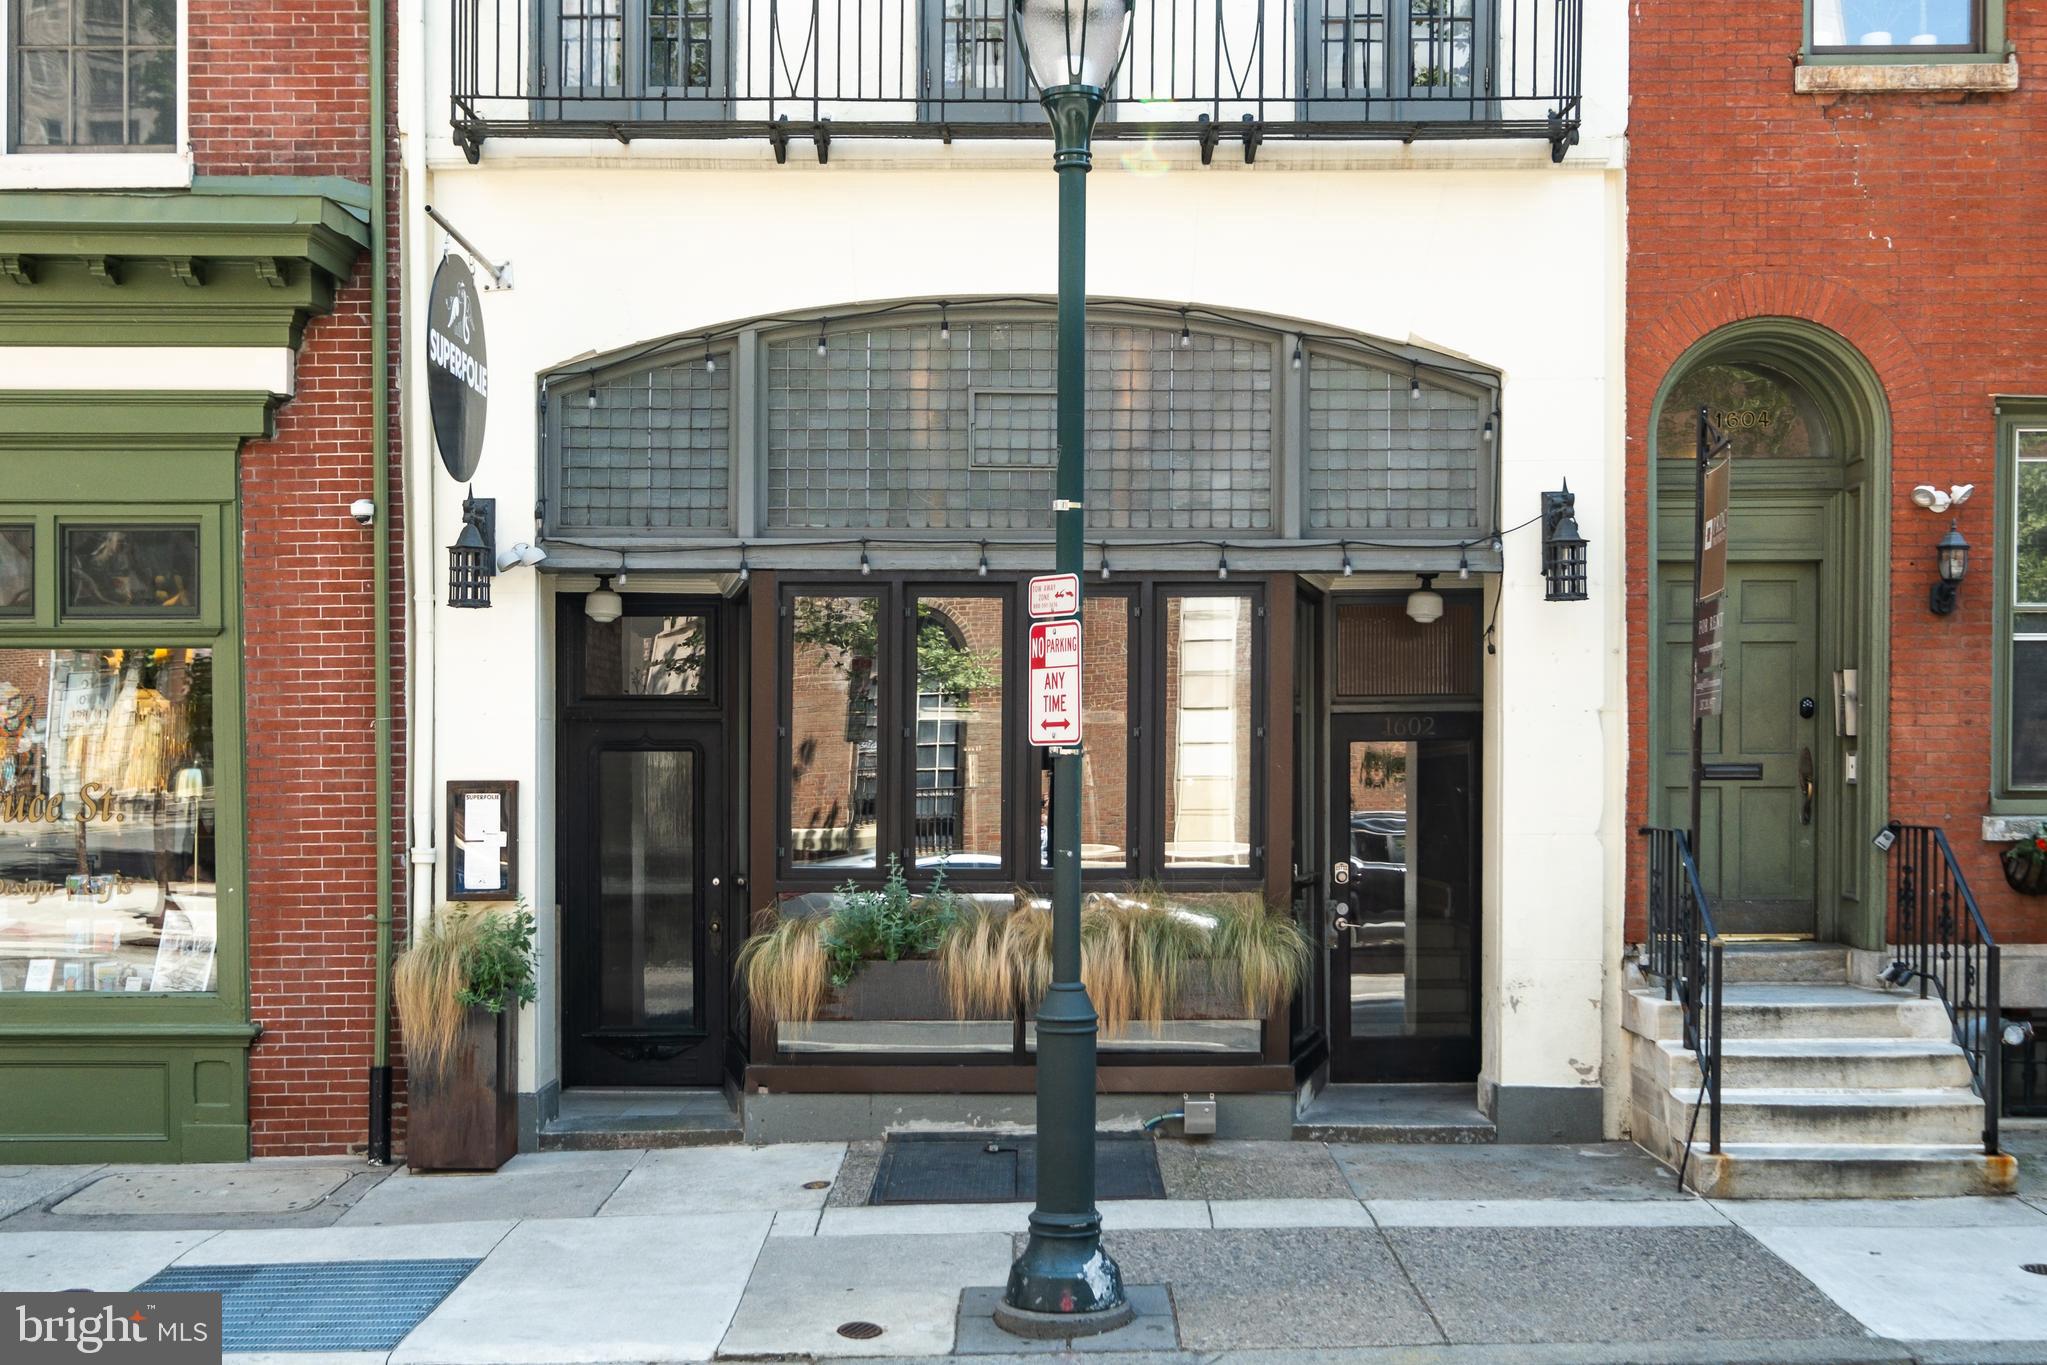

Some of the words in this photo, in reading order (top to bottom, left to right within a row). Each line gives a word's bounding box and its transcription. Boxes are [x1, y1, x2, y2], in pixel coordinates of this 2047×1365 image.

[430, 328, 488, 398] SUPERFOLIE
[1716, 410, 1770, 428] 1604
[1038, 593, 1050, 601] ZONE
[1031, 637, 1045, 659] NO
[1046, 636, 1077, 653] PARKING
[1044, 672, 1065, 690] ANY
[1043, 694, 1067, 713] TIME
[1383, 716, 1436, 736] 1602
[0, 793, 65, 823] uce
[76, 782, 125, 822] St.
